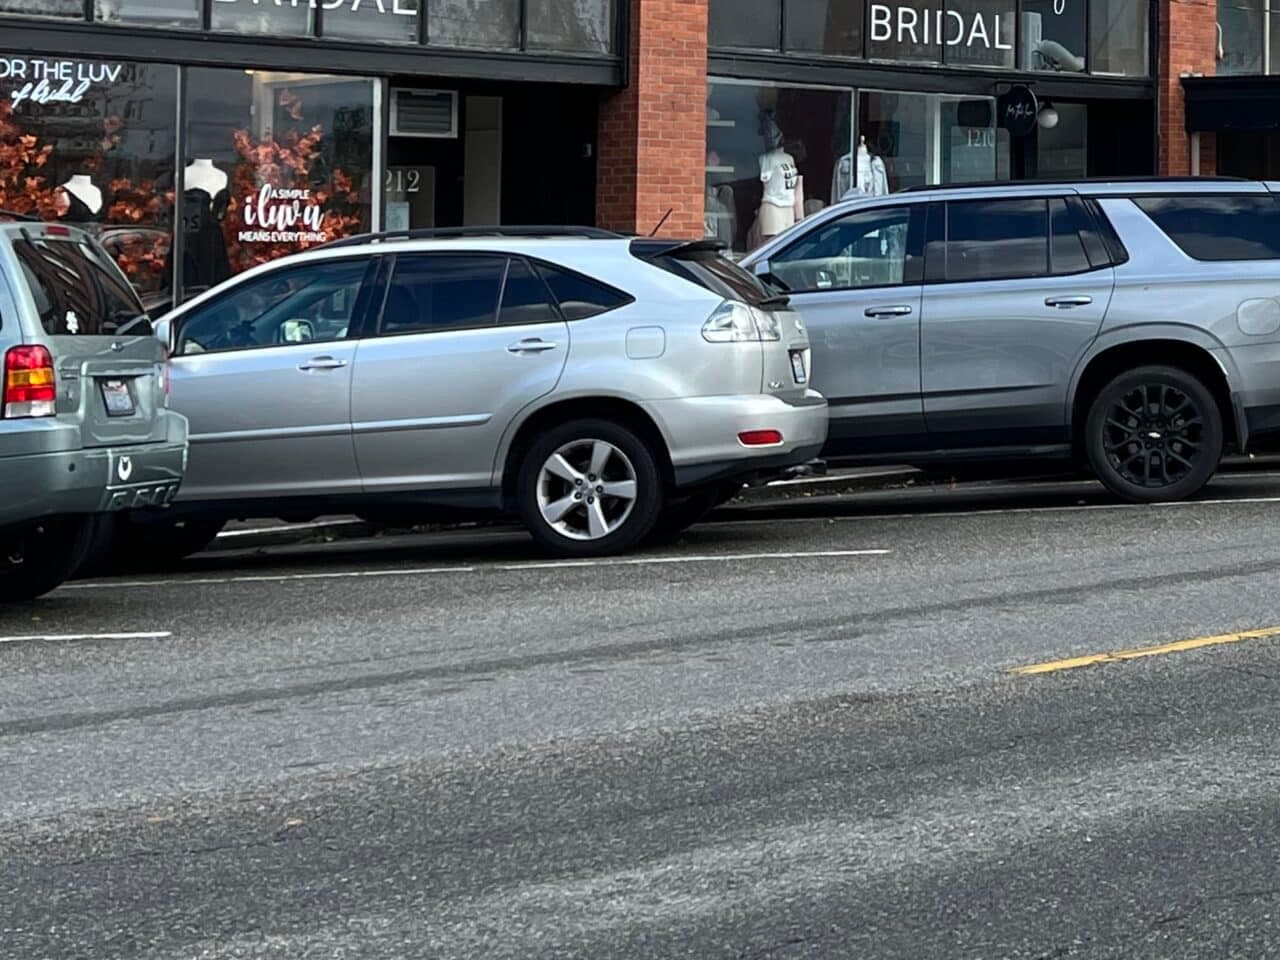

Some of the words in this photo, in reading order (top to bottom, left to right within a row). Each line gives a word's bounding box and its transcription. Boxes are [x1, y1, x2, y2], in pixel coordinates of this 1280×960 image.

[870, 4, 1013, 50] BRIDAL
[30, 60, 73, 80] THE
[77, 63, 122, 82] LUV
[11, 82, 33, 109] of
[30, 78, 91, 104] bridal
[244, 196, 257, 226] i
[258, 183, 302, 232] luv
[303, 205, 325, 232] u
[271, 189, 278, 199] A
[279, 189, 310, 200] SIMPLE
[238, 231, 270, 242] MEANS
[271, 231, 327, 243] EVERYTHING
